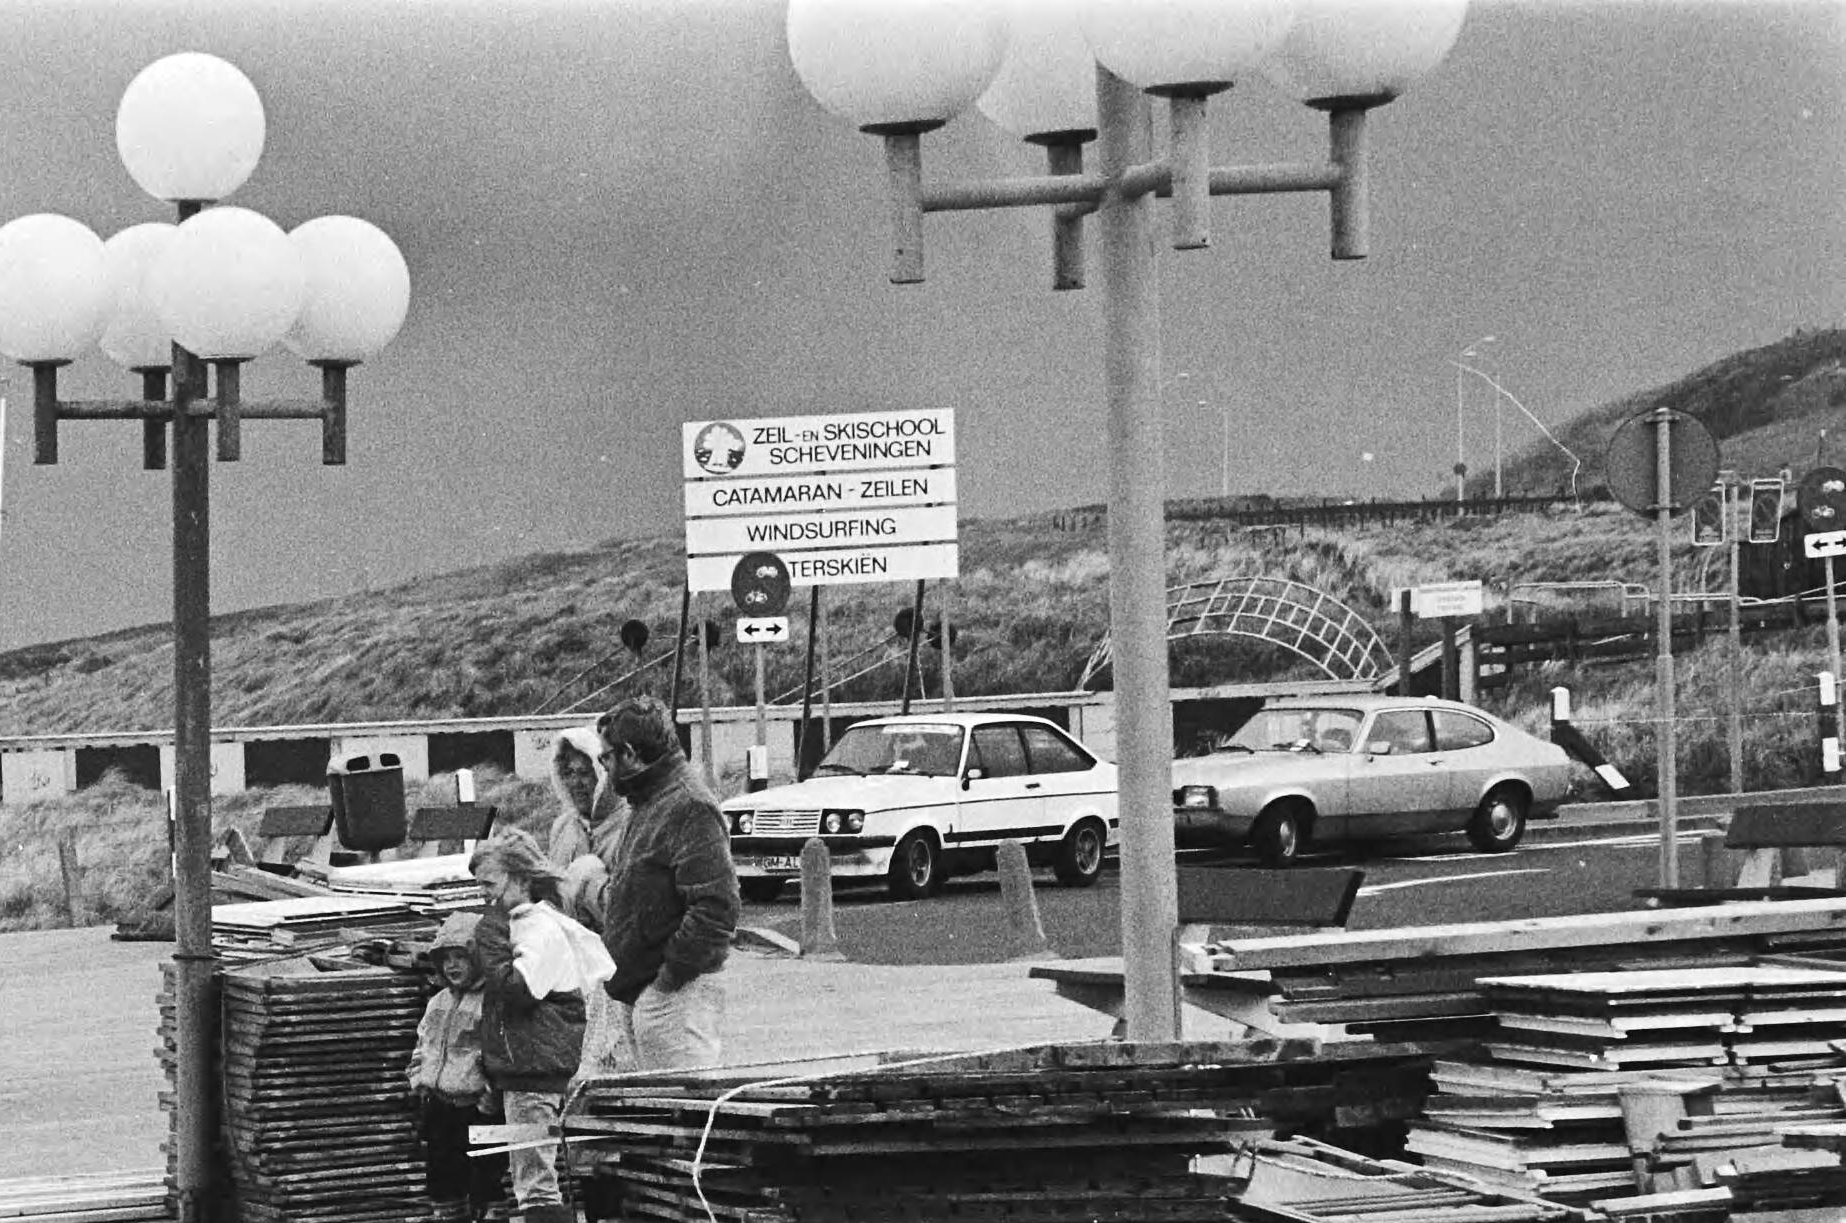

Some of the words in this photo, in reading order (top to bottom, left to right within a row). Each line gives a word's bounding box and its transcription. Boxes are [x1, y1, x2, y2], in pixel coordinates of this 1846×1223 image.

[823, 418, 945, 441] SKISCHOOL
[769, 439, 931, 465] SCHEVENINGEN
[712, 483, 842, 507] CATAMARAN
[860, 478, 928, 499] ZEILEN
[746, 517, 897, 542] WINDSURFING
[788, 552, 887, 578] TERSKIËN
